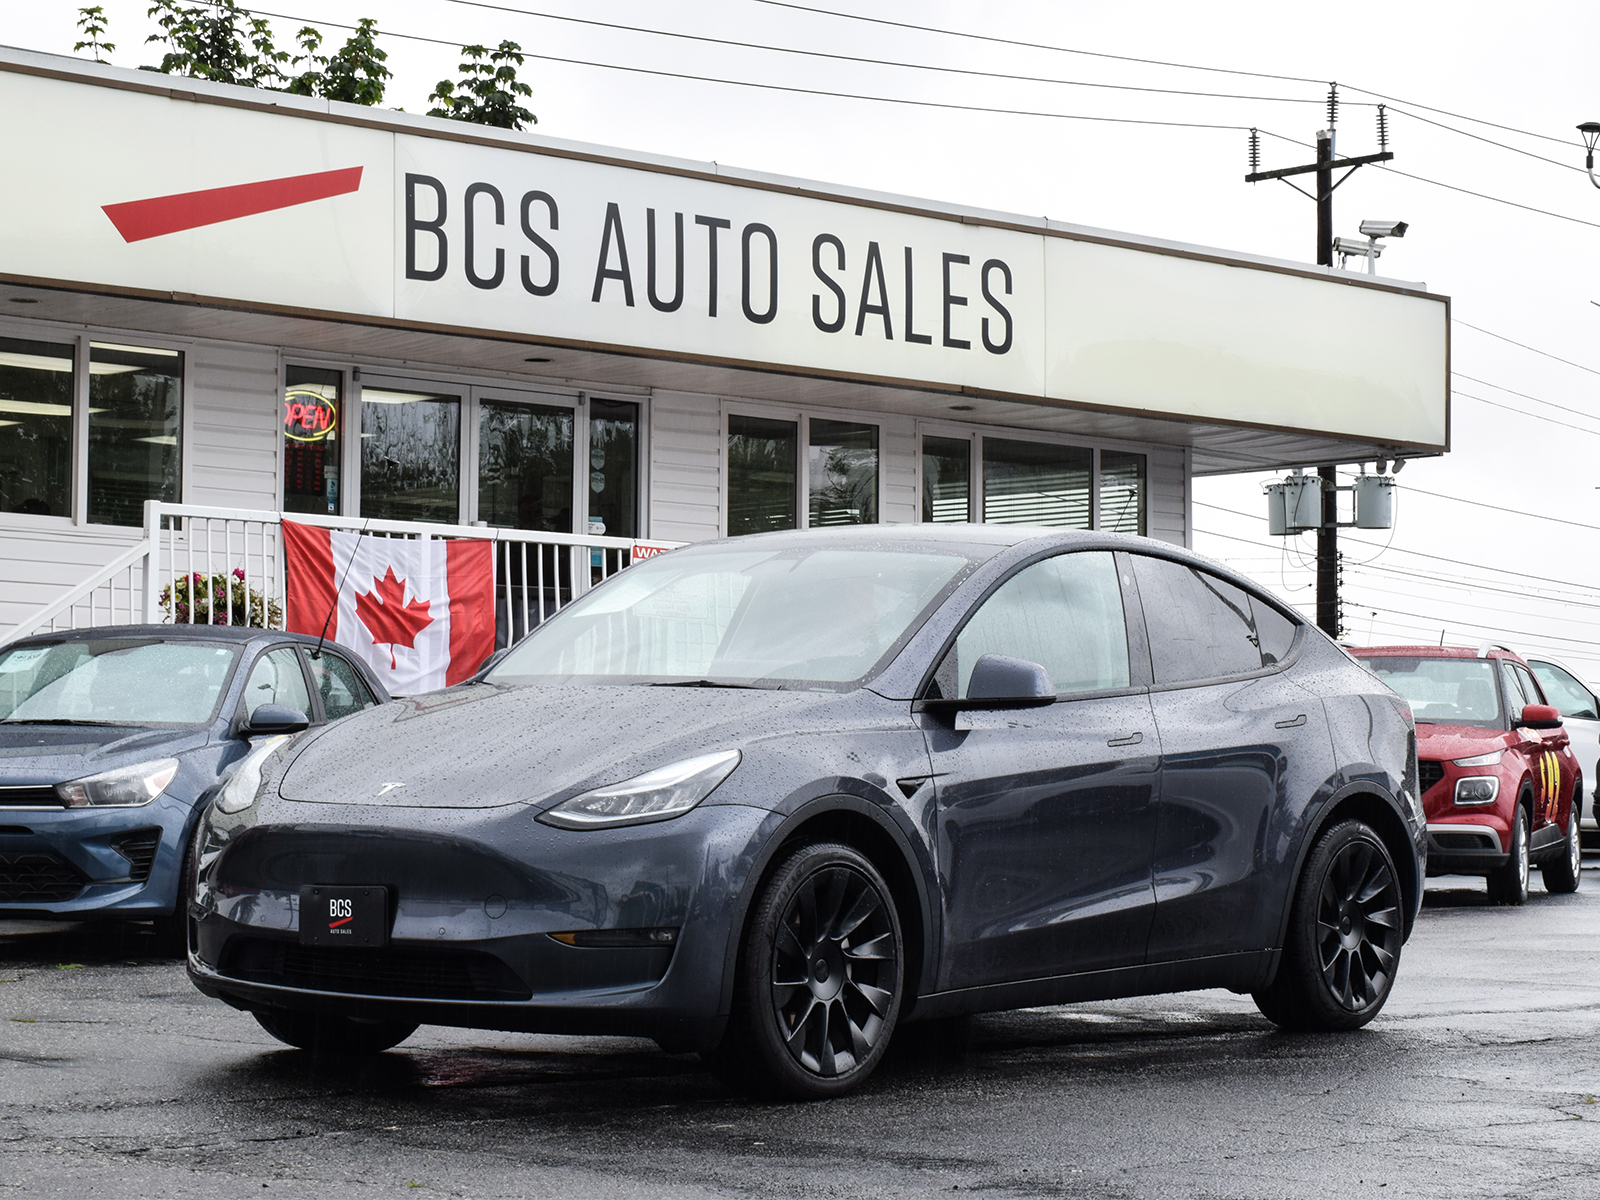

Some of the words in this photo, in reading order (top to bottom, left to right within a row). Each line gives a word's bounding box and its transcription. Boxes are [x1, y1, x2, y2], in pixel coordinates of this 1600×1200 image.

[405, 172, 559, 297] BCS
[591, 202, 778, 324] AUTO
[812, 233, 1013, 355] SALES
[330, 899, 352, 917] BCS
